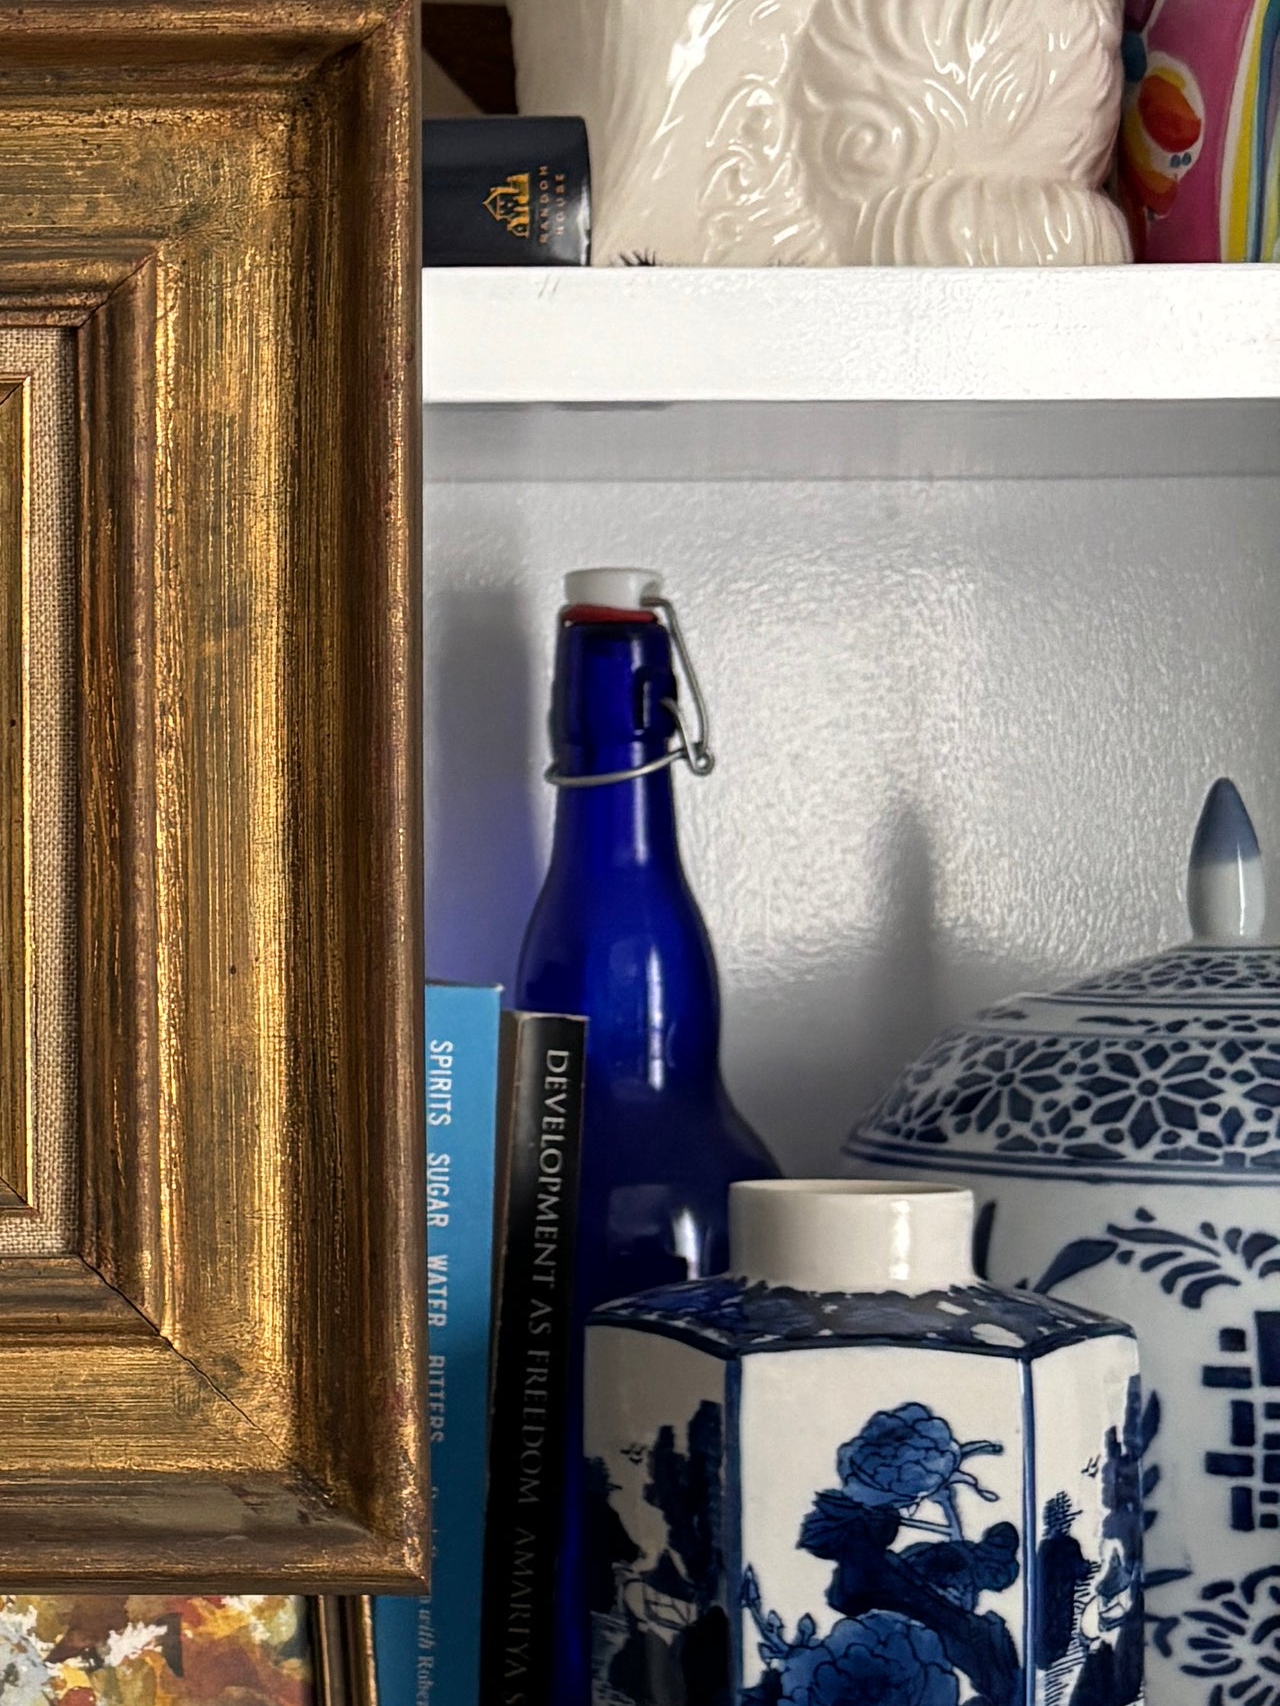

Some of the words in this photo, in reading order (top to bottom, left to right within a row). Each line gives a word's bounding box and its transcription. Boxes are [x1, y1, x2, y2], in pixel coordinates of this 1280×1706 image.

[428, 1039, 454, 1127] SPIRITS
[426, 1152, 451, 1228] SUGAR
[533, 1049, 570, 1290] DEVELOPMENT
[426, 1253, 449, 1328] WATER
[527, 1298, 553, 1335] AS
[517, 1349, 551, 1504] FREEDOM
